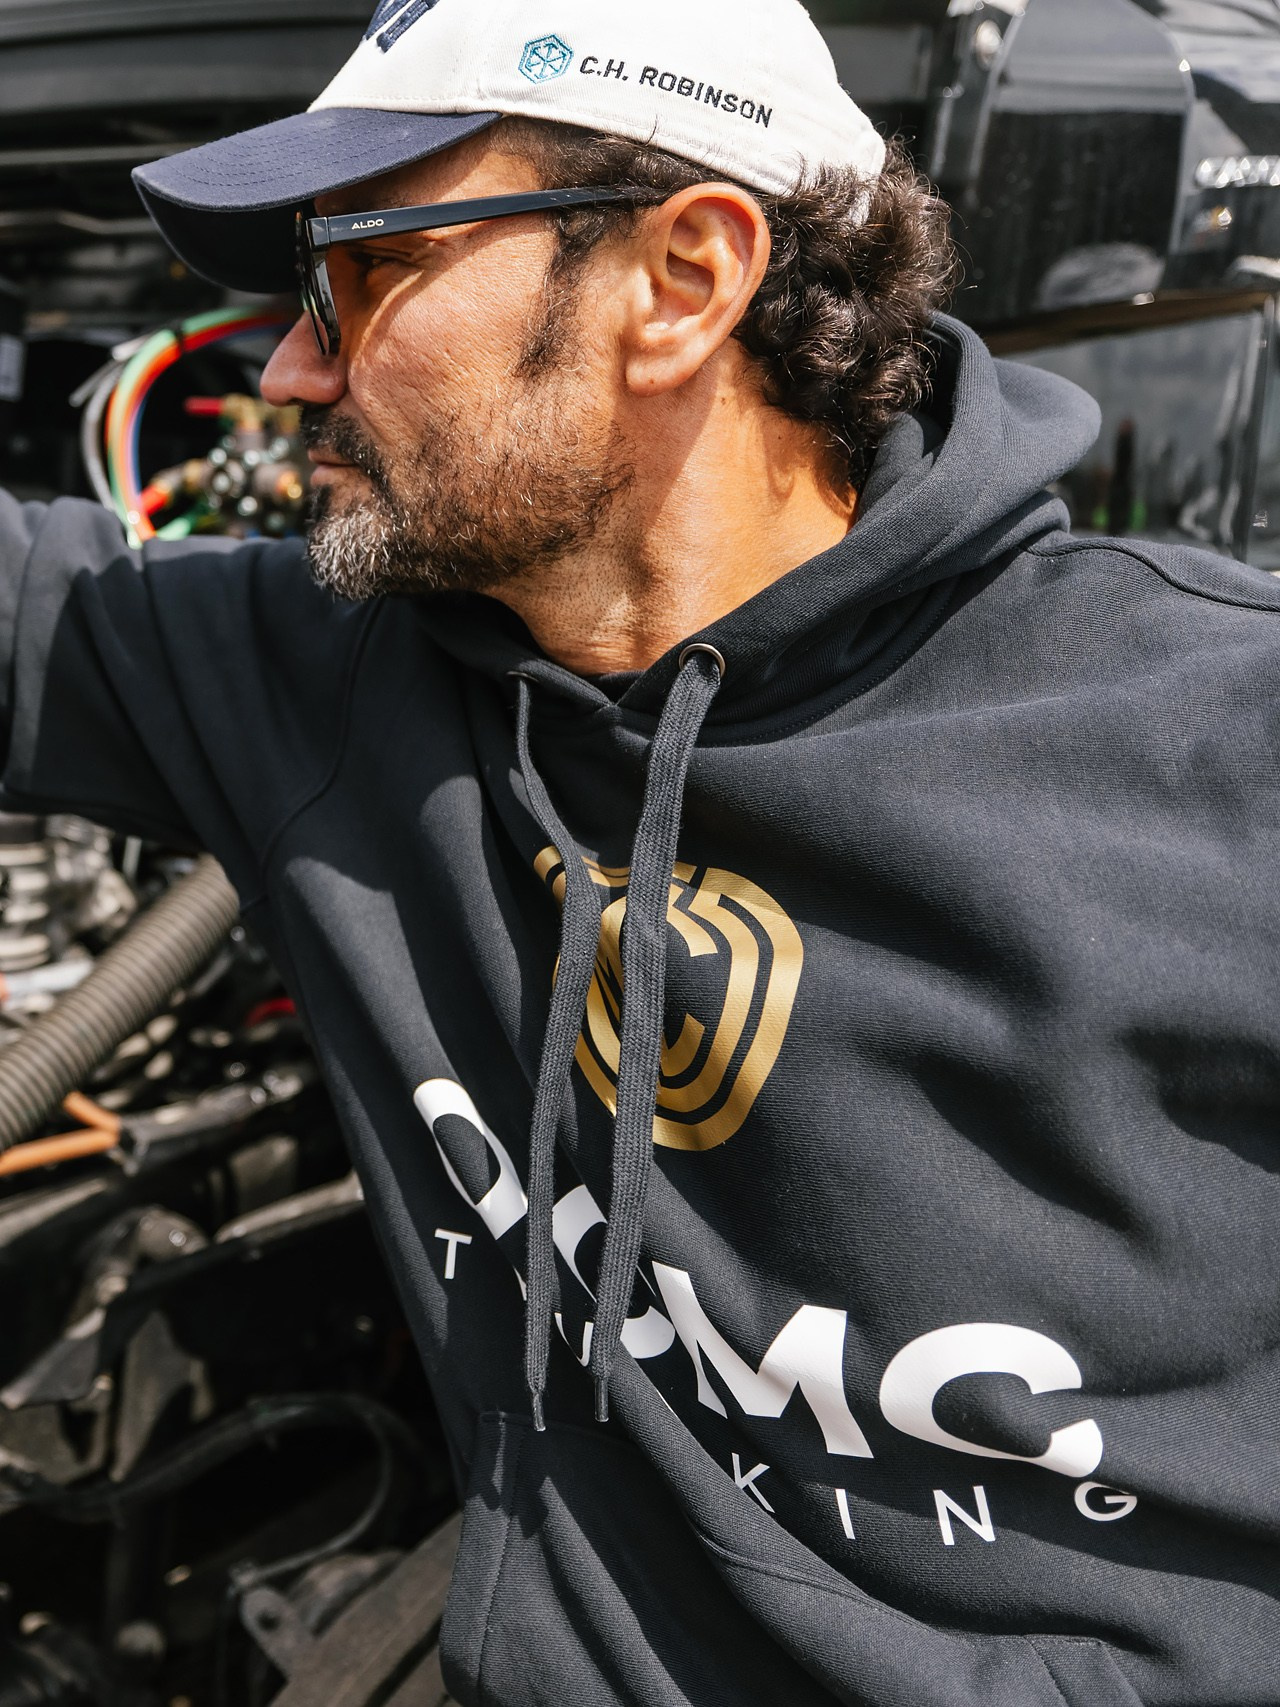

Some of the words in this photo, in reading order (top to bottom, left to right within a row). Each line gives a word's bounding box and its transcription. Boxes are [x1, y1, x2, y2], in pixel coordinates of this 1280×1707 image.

[579, 55, 629, 82] C.H.
[638, 65, 773, 129] ROBINSON
[351, 218, 385, 231] ALDO
